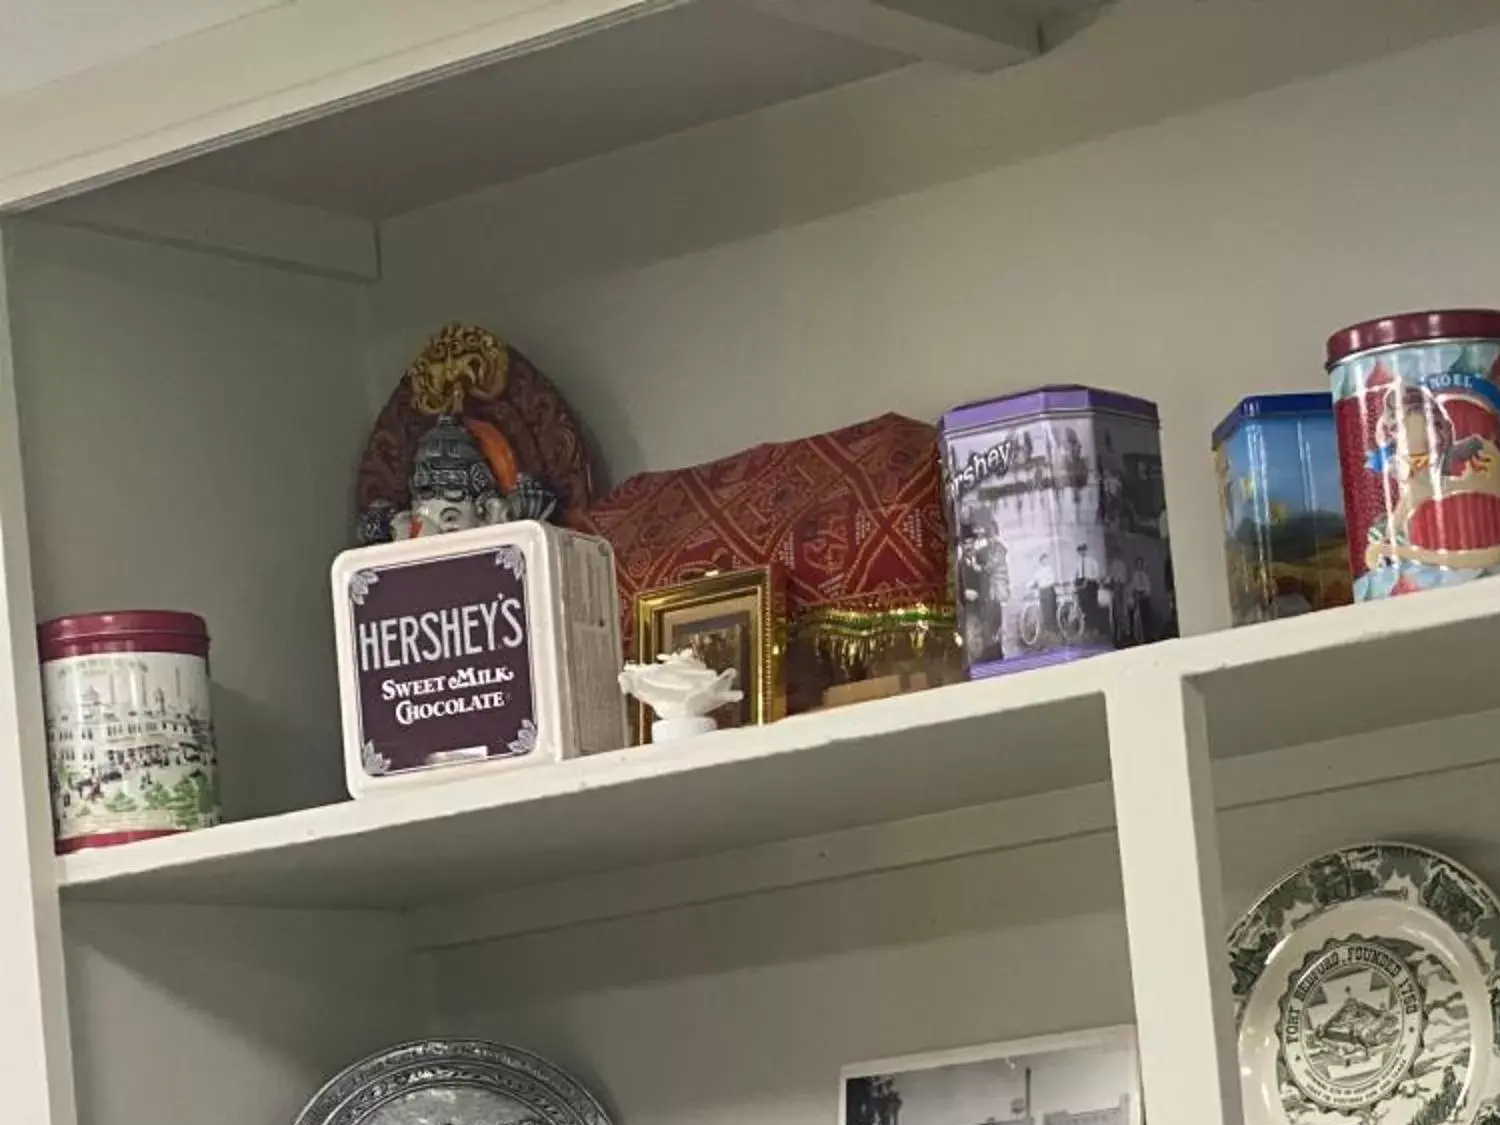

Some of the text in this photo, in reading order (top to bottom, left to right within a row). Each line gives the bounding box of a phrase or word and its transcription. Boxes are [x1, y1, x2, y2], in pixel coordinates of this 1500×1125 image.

[952, 443, 1010, 496] rshey
[358, 592, 523, 672] HERSHEY'S
[381, 665, 514, 701] SWEET MILK
[395, 691, 505, 725] CHOCOLATE
